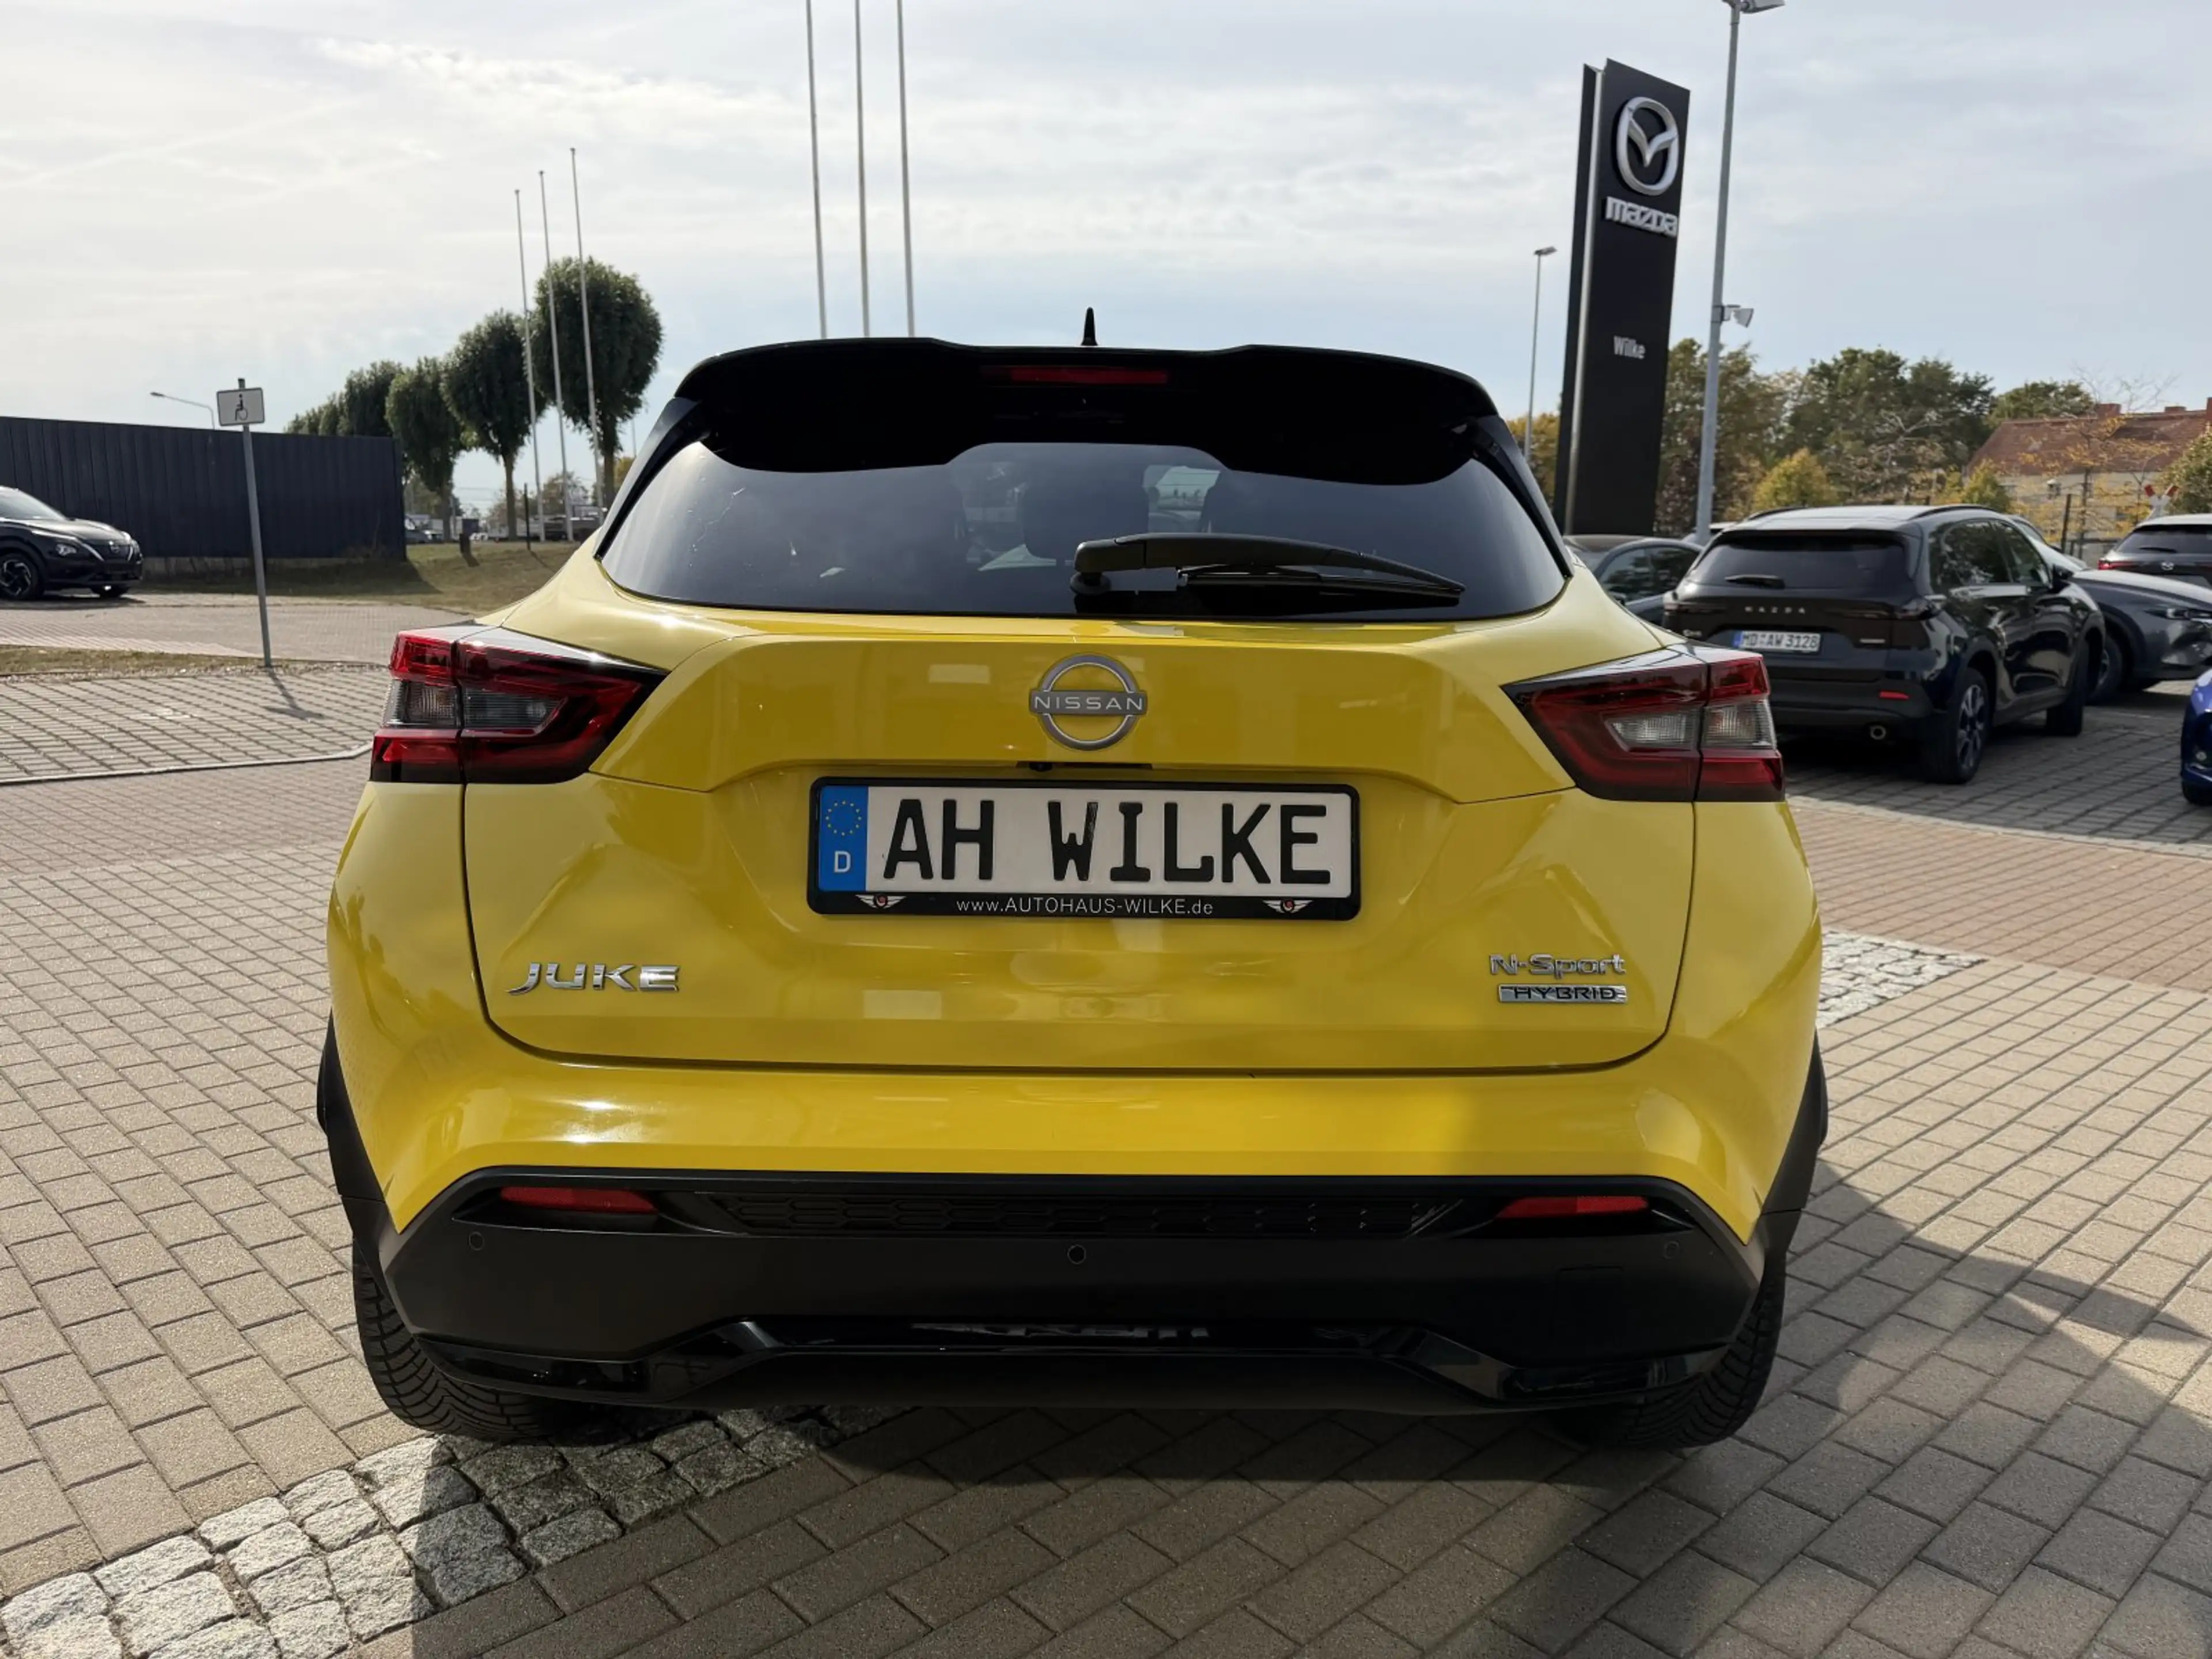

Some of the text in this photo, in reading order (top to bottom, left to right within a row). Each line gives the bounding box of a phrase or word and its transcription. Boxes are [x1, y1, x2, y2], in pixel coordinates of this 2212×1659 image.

[1613, 335, 1646, 359] Wilke
[1034, 696, 1142, 710] NISSAN
[883, 798, 1331, 884] AH WILKE
[834, 851, 851, 873] D
[956, 897, 1213, 915] www.AUTOHAUS-WILKE.de
[1489, 954, 1626, 979] N-Sport
[504, 962, 680, 996] JUKE
[1513, 986, 1616, 1000] HYBRID
